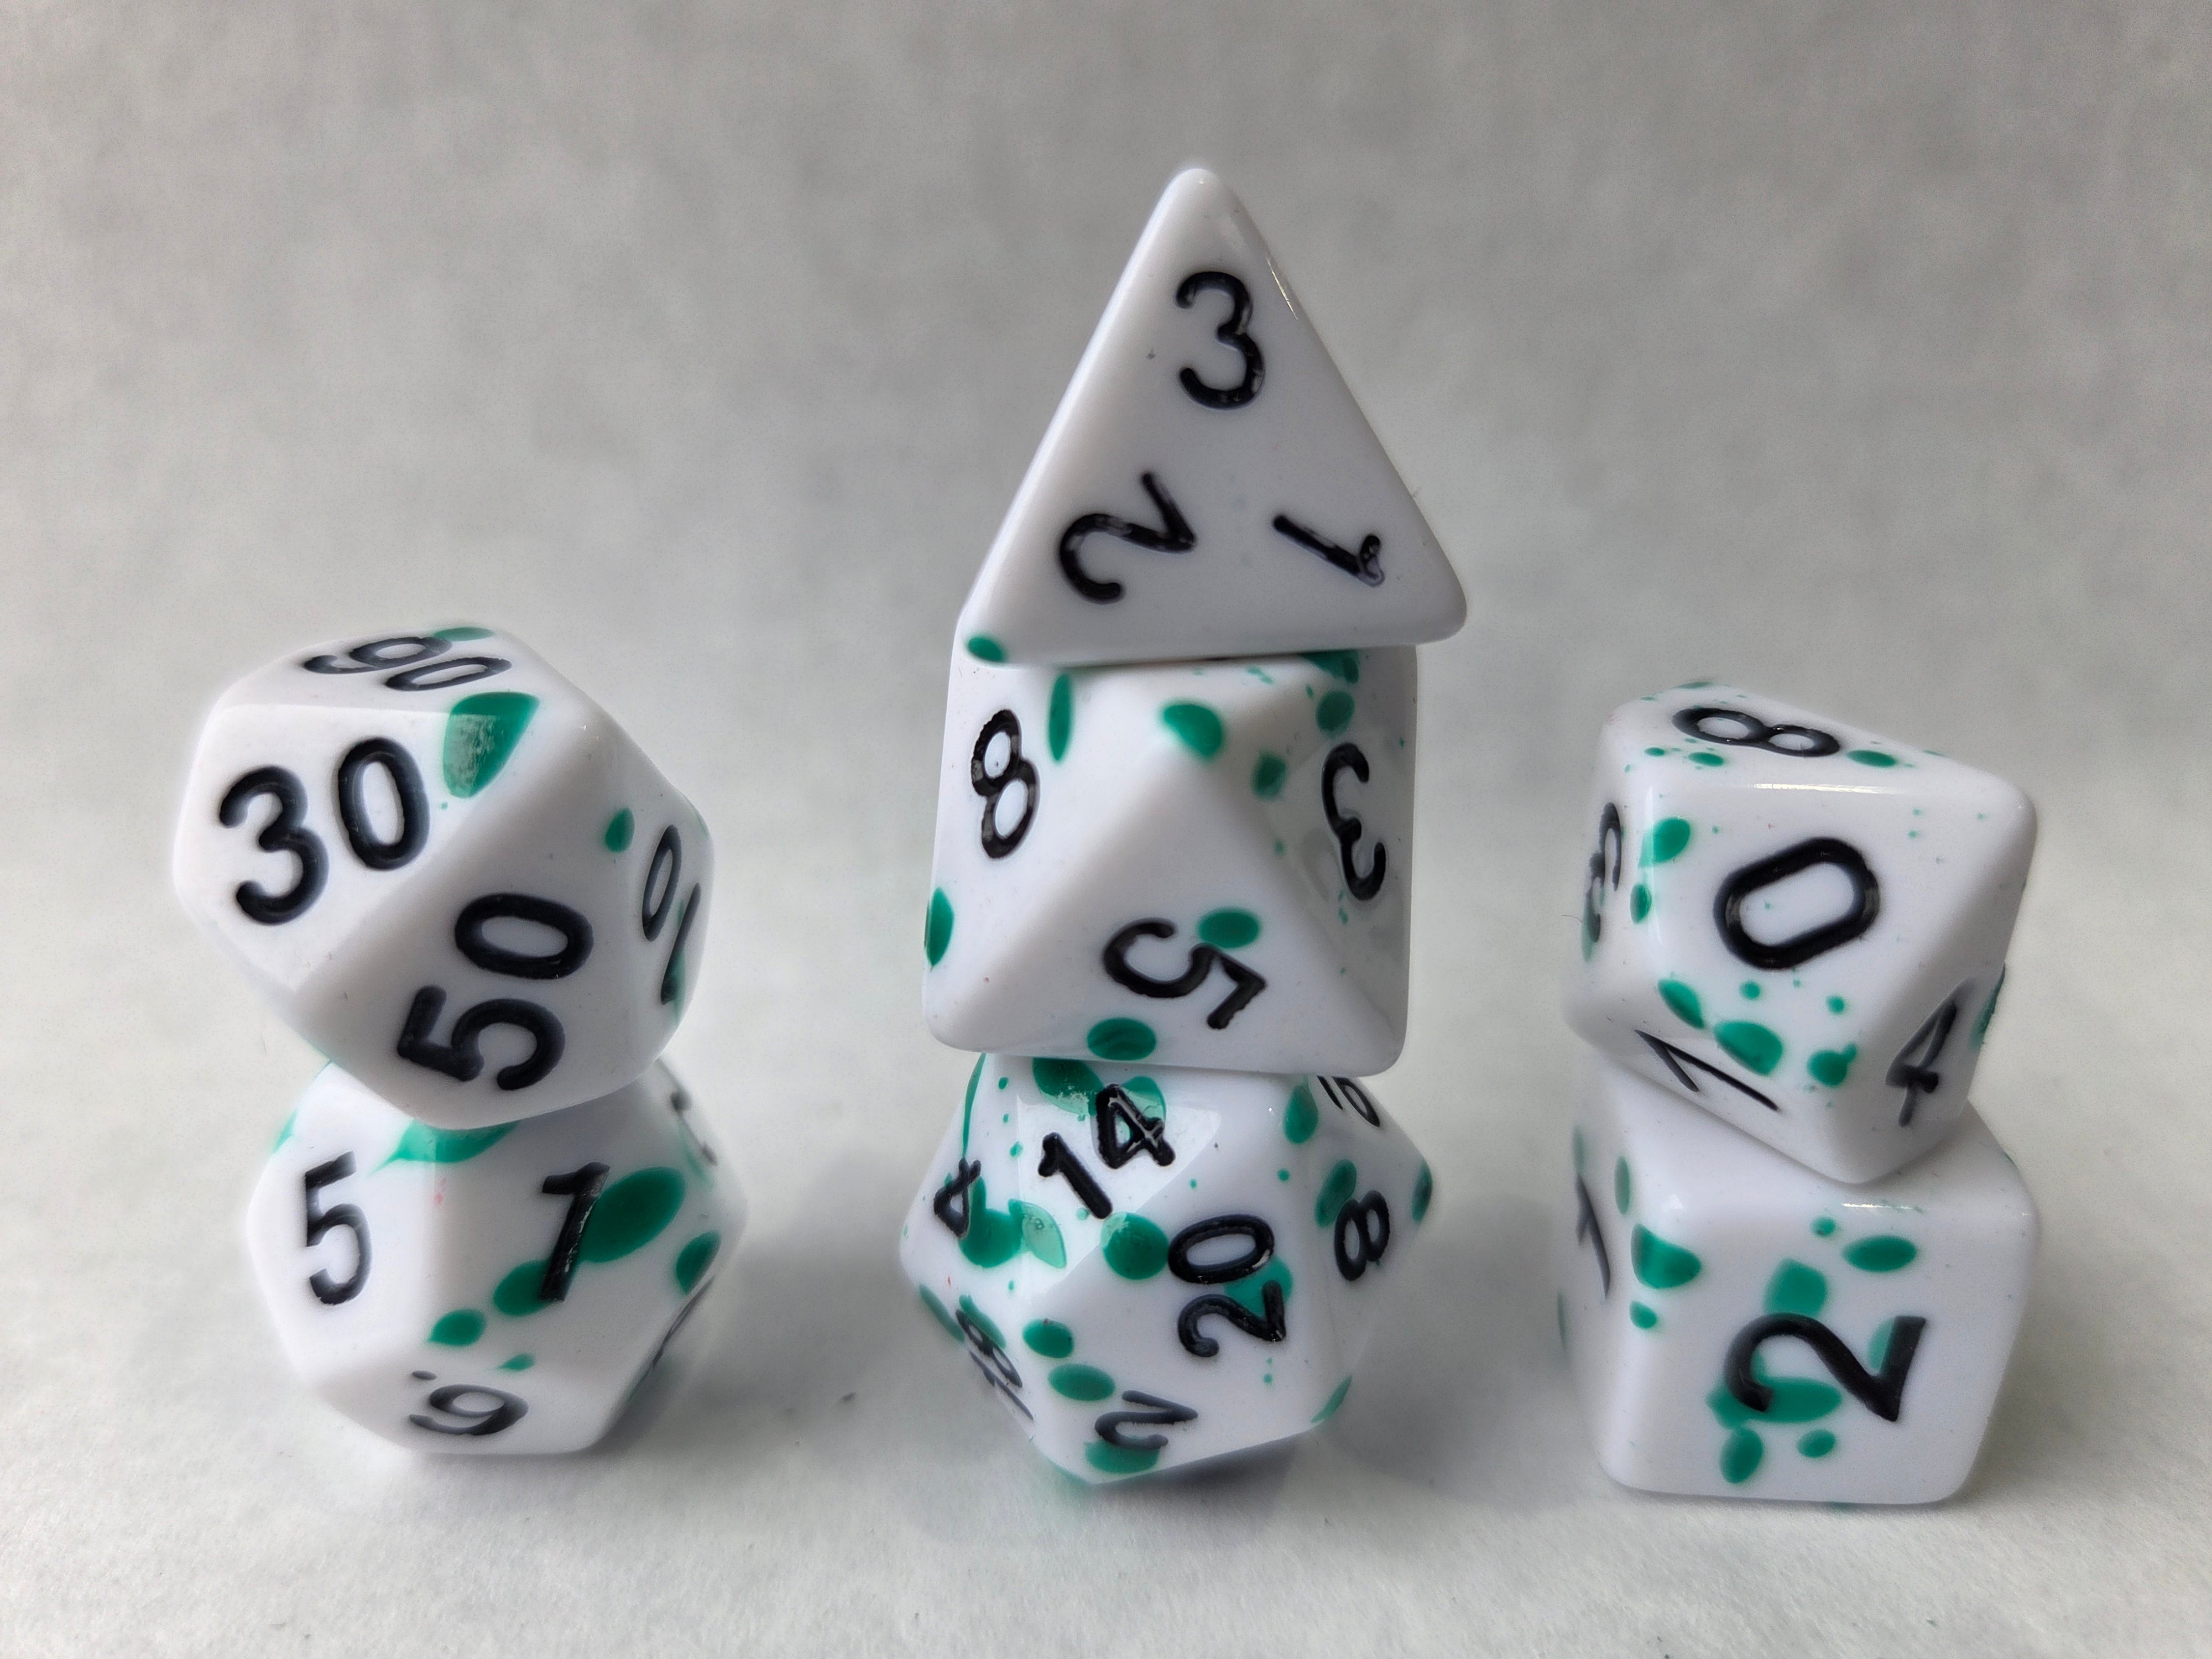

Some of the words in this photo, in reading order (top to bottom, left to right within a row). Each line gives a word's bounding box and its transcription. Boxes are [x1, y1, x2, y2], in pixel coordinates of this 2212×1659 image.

[1175, 270, 1265, 411] 3
[1057, 473, 1195, 606] 2
[1271, 514, 1386, 588] 1
[970, 708, 1041, 860] 8
[1672, 707, 1841, 758] 8
[220, 737, 430, 927] 30
[1322, 742, 1387, 901] 3
[1712, 836, 1879, 971] 0
[395, 893, 595, 1092] 50
[1102, 917, 1266, 1030] 5
[1885, 978, 1966, 1127] 4
[933, 1157, 982, 1239] 4
[1037, 1083, 1176, 1219] 14
[304, 1151, 373, 1306] 5
[542, 1161, 611, 1302] 1
[1167, 1214, 1286, 1358] 20
[1334, 1190, 1390, 1281] 8
[1094, 1390, 1199, 1450] 2
[1724, 1313, 1927, 1422] 2
